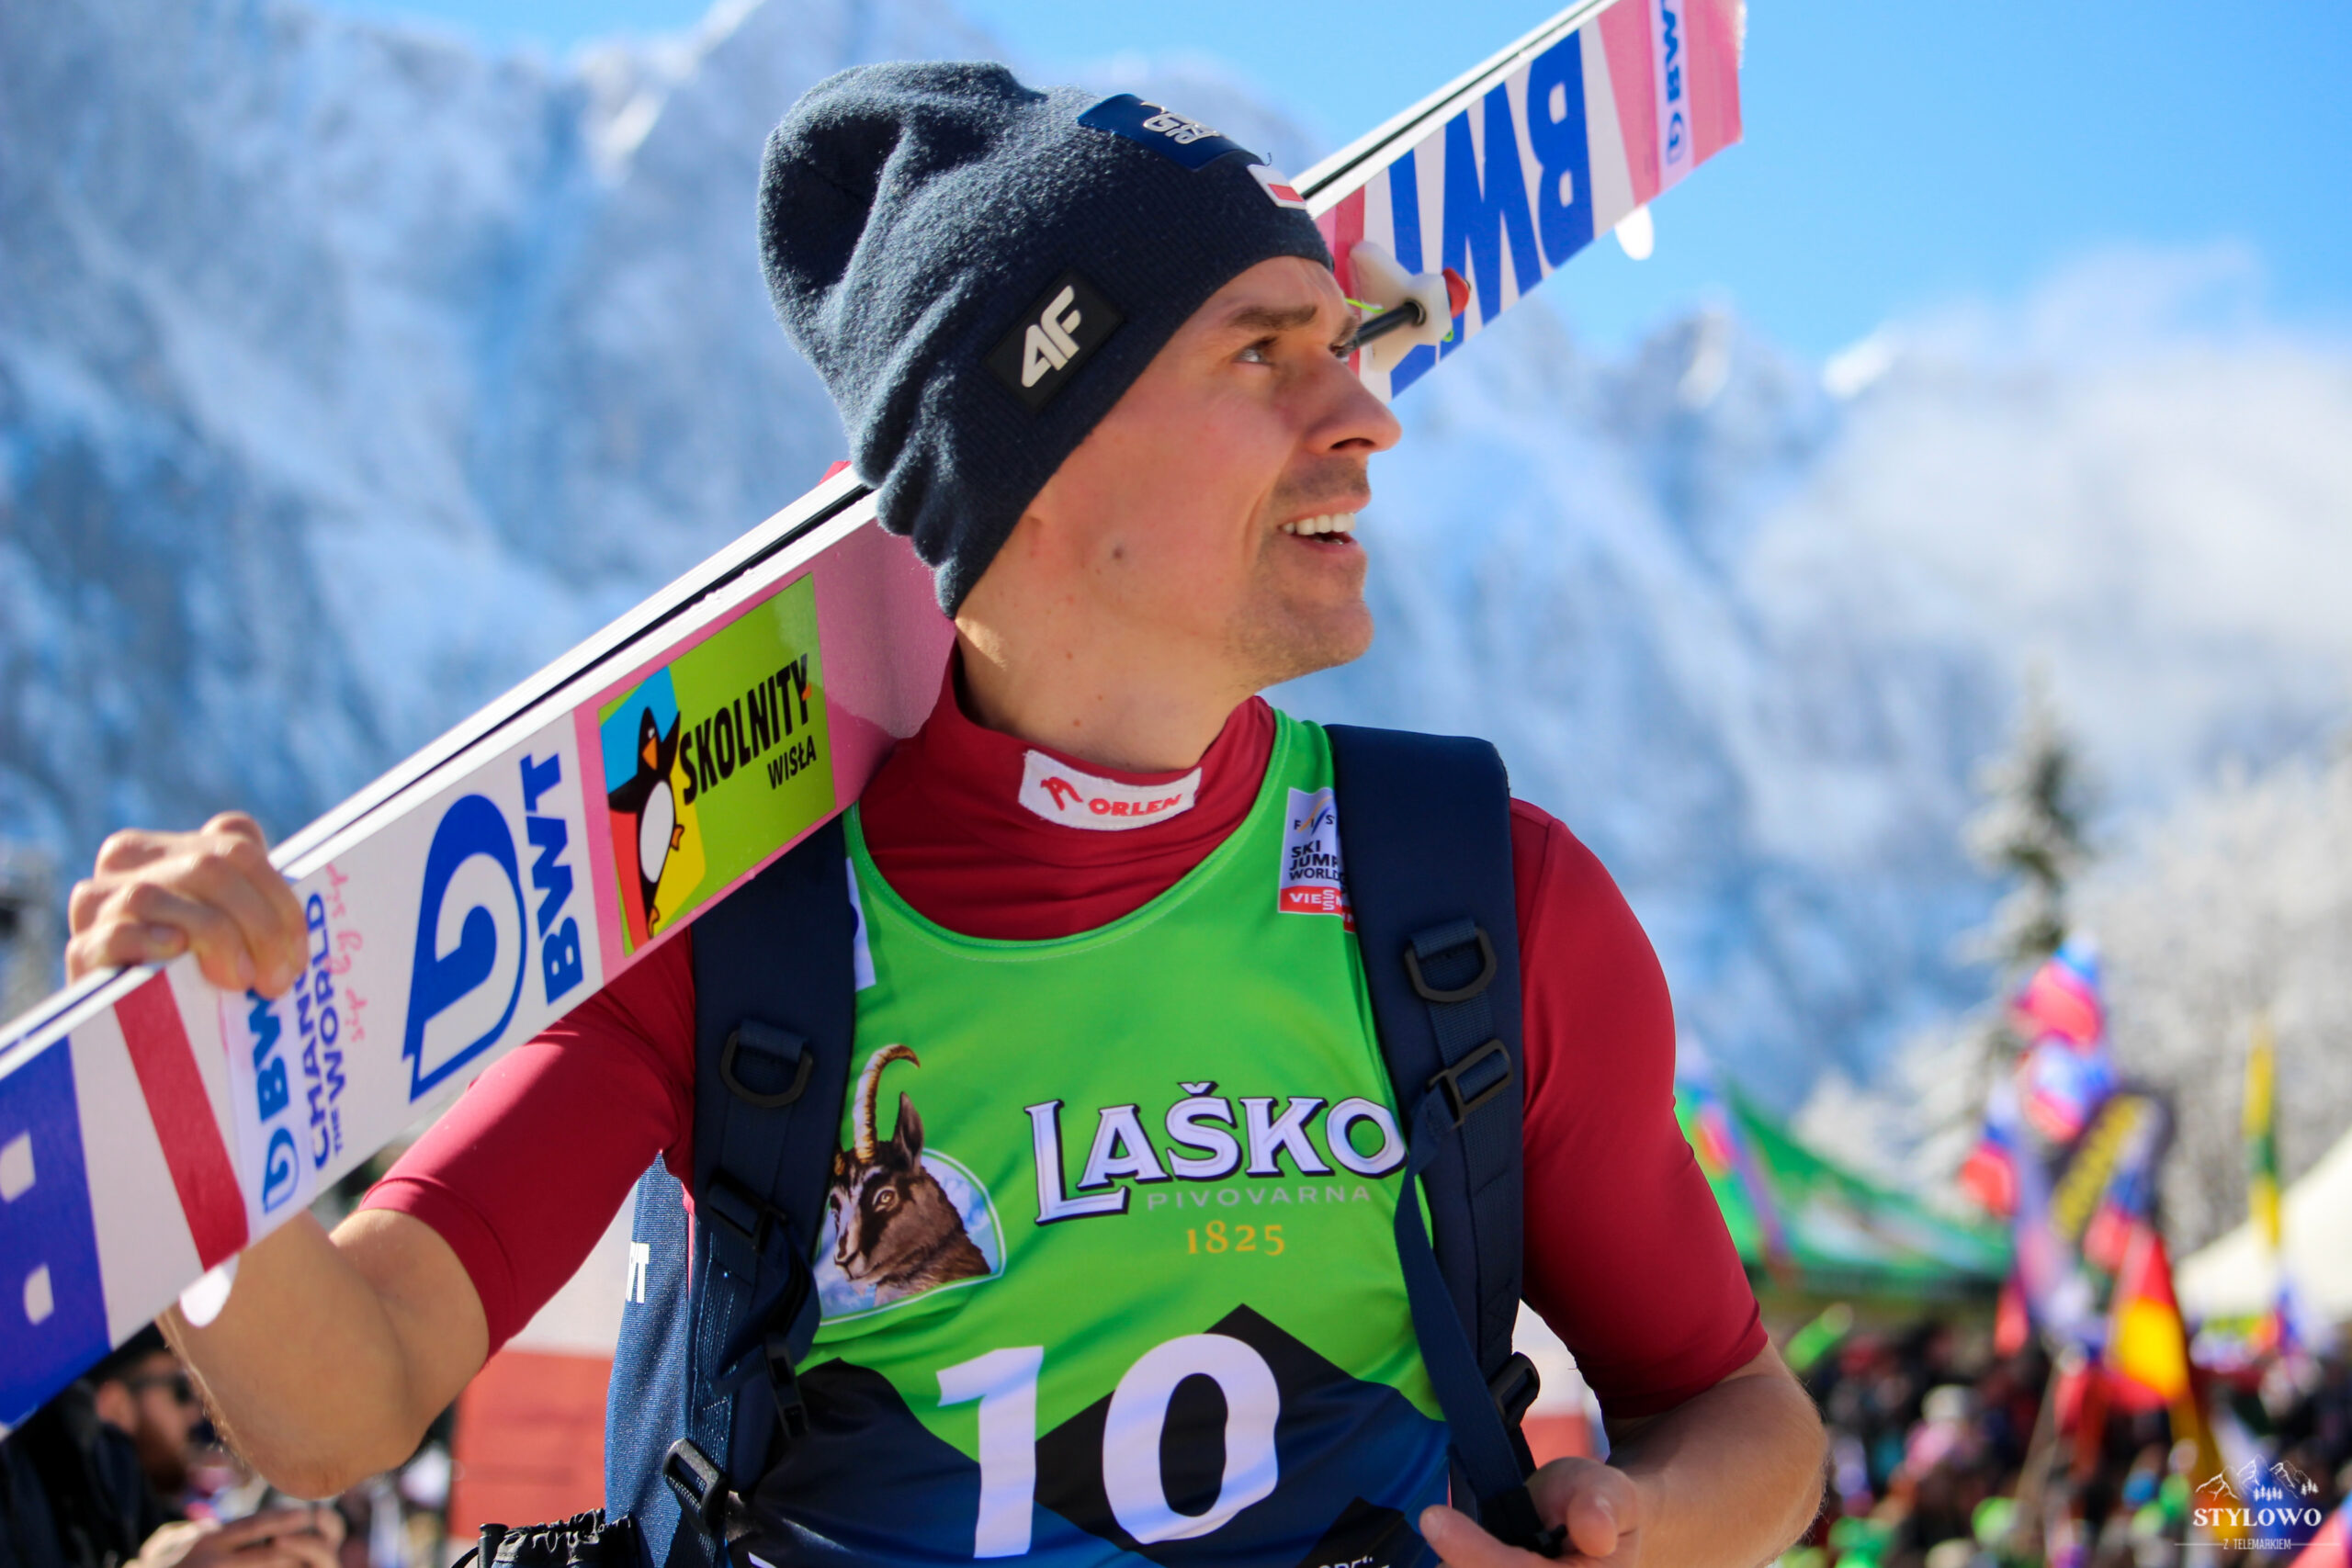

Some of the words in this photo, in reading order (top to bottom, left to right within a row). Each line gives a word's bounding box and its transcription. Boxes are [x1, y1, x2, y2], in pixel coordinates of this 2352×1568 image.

[1660, 0, 1681, 106] BW
[1021, 284, 1082, 388] 4F
[679, 652, 812, 806] SKOLNITY
[766, 734, 818, 791] WISŁA
[1088, 793, 1183, 817] ORLEN
[1291, 840, 1321, 859] SKI
[519, 752, 584, 1007] BWT
[1289, 852, 1339, 871] JUMP
[1289, 867, 1340, 881] WORLD
[305, 890, 346, 1103] WORLD
[245, 987, 291, 1122] BW
[294, 968, 330, 1171] CHAN
[1023, 1080, 1408, 1227] LAŠKO
[1148, 1185, 1372, 1212] PIVOVARNA
[1186, 1220, 1285, 1257] 1825
[935, 1332, 1282, 1560] 10
